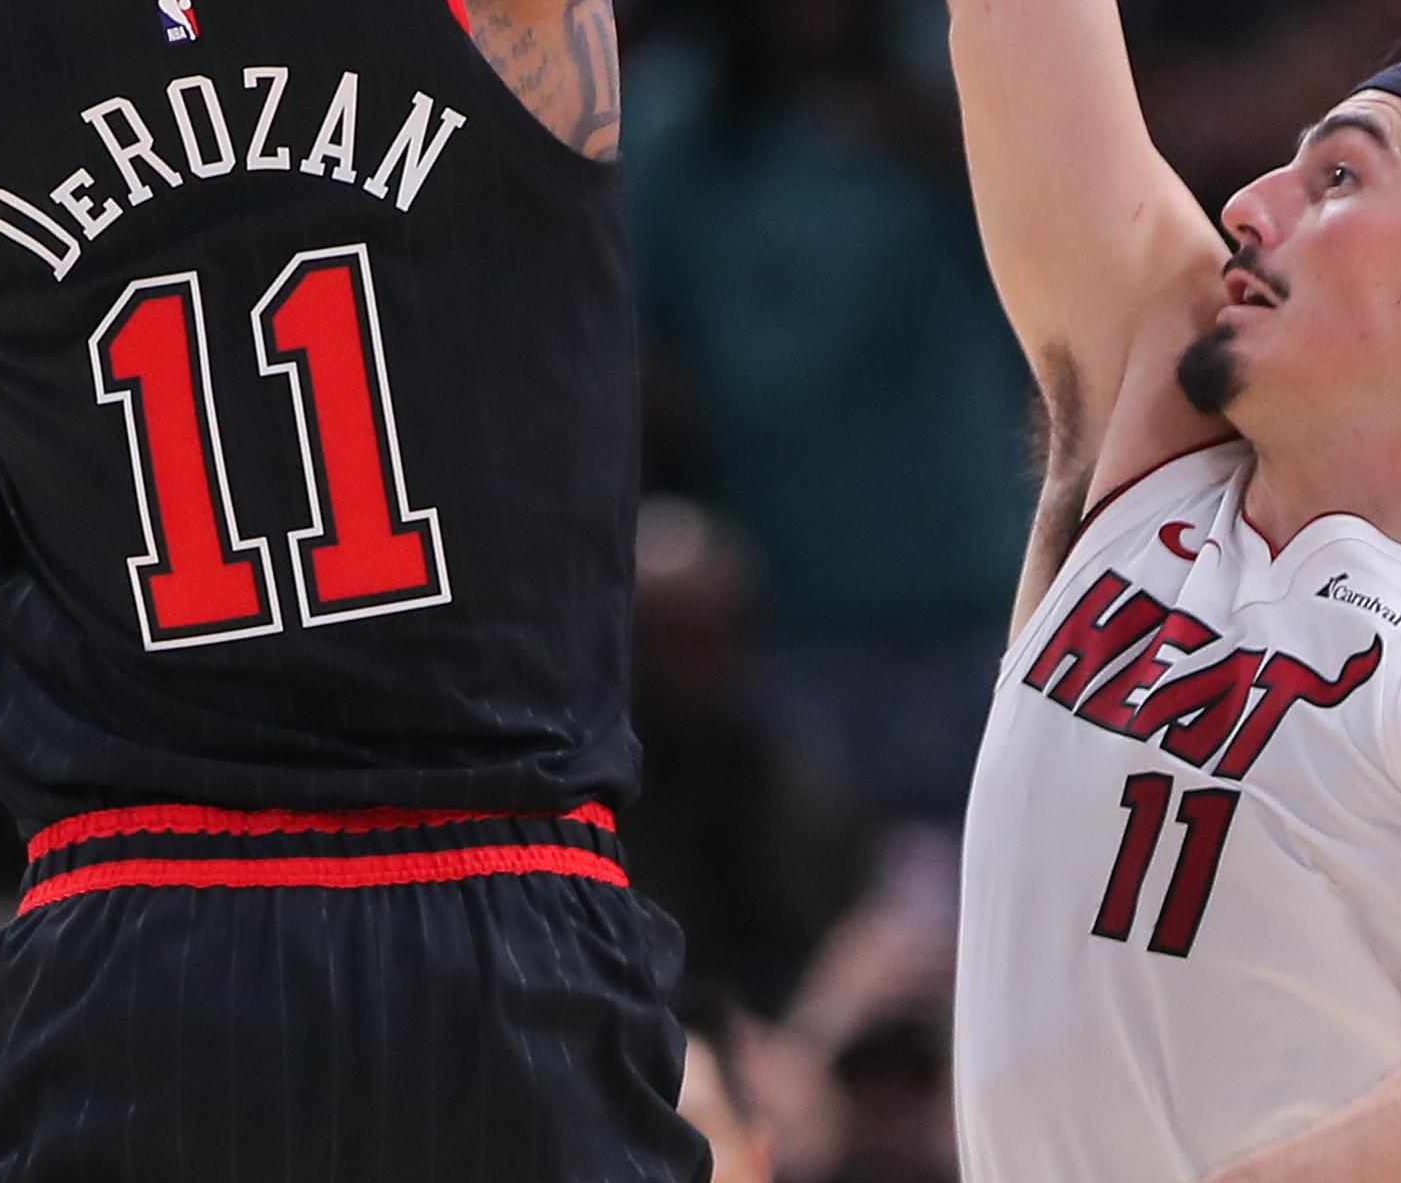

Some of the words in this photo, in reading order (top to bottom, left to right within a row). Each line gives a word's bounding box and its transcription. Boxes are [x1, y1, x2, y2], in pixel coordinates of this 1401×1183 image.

[87, 242, 453, 652] 11
[1021, 567, 1383, 782] HEAT
[1090, 770, 1242, 959] 11
